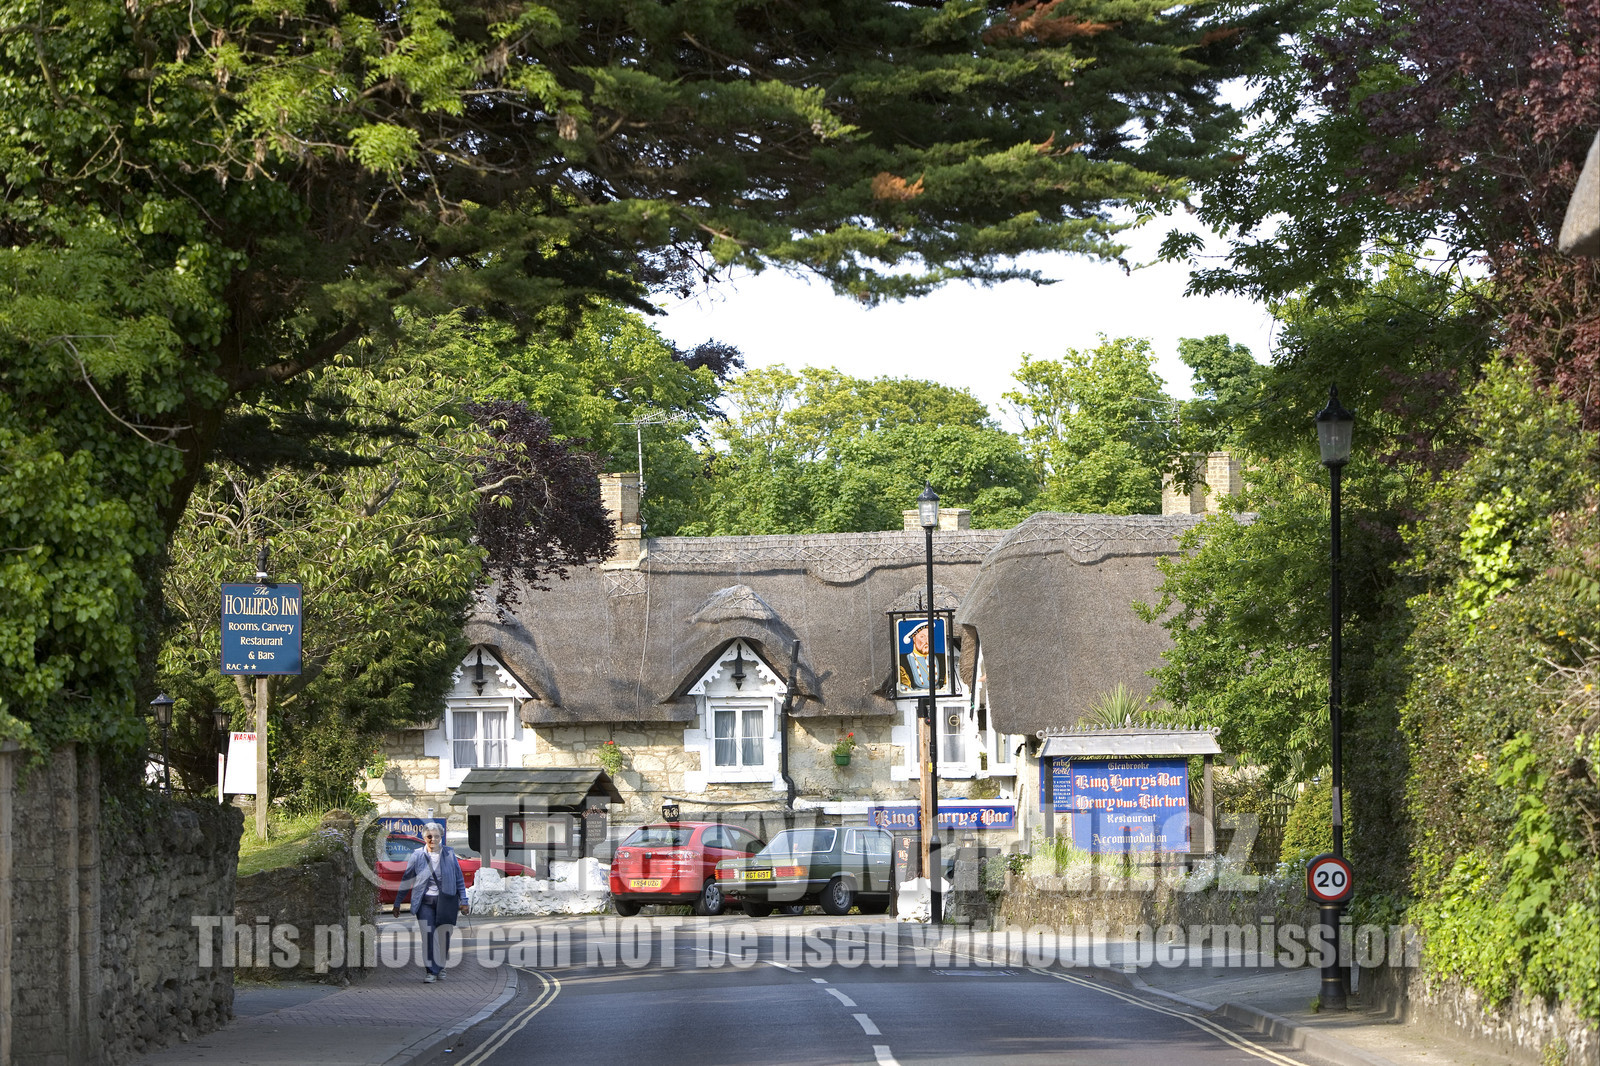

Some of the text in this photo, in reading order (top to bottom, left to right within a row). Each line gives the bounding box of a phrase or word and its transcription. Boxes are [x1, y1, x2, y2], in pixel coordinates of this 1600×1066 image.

[252, 586, 270, 596] The
[224, 594, 299, 616] HOLLIERS INN
[228, 621, 294, 635] Rooms, Carvery
[240, 636, 283, 646] Restaurant
[247, 650, 275, 660] & Bars
[233, 733, 257, 741] WARNIN
[1107, 761, 1150, 770] Glenbrooke
[1074, 772, 1184, 792] King Harry's Bar
[1075, 794, 1115, 814] Henry
[1138, 793, 1187, 810] Kitchen
[873, 808, 1010, 828] King arry's Bar
[1107, 813, 1156, 823] Restaurant
[1092, 832, 1167, 845] Accommodation
[1317, 871, 1345, 887] 20
